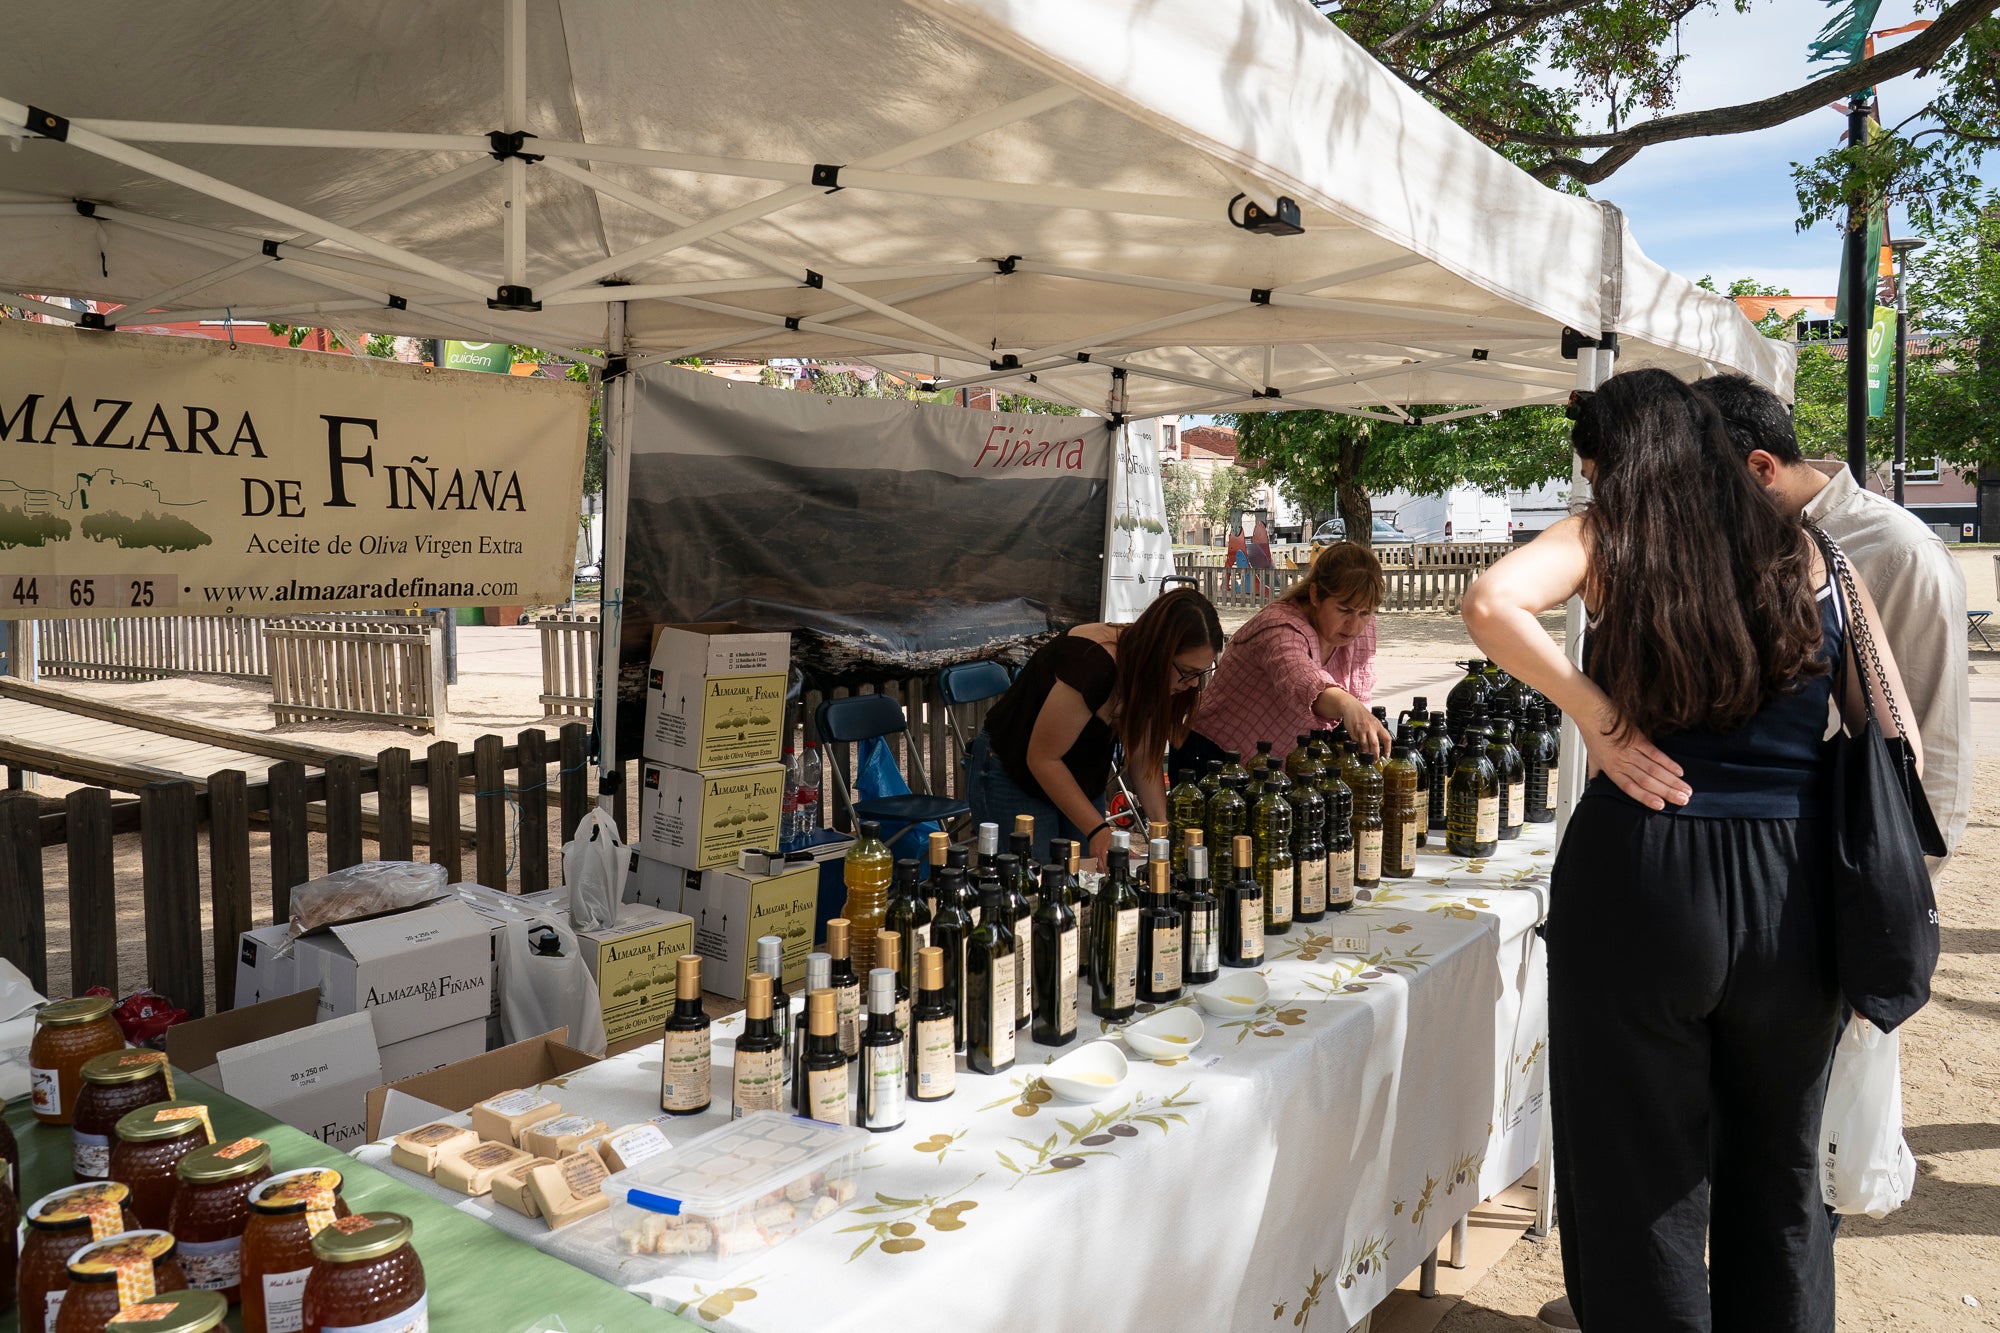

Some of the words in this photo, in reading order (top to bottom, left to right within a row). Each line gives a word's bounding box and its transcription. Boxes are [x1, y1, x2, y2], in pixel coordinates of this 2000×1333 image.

[450, 351, 492, 367] cuidem
[973, 425, 1085, 470] Fiñana
[240, 477, 306, 518] DE
[319, 414, 527, 512] FIÑANA
[245, 533, 320, 554] Aceite
[327, 535, 352, 555] de
[359, 535, 408, 555] Oliva
[414, 535, 472, 558] Virgen
[479, 536, 523, 554] Extra
[12, 577, 39, 605] 44
[70, 579, 95, 606] 65
[130, 581, 154, 607] 25
[203, 577, 519, 602] www.almazaradefinana.com
[710, 682, 750, 697] ALMAZARA
[709, 782, 748, 797] ALMAZARA
[753, 904, 788, 919] ALMAZARA
[607, 946, 651, 963] ALMAZARA
[648, 953, 655, 961] DE
[657, 940, 686, 957] FIÑANA
[364, 980, 437, 1009] ALMAZARA
[424, 991, 437, 1002] DE
[438, 975, 485, 998] FIÑANA
[290, 1072, 300, 1082] 20
[300, 1071, 305, 1079] x
[305, 1066, 318, 1078] 250
[321, 1121, 367, 1146] FIÑAN
